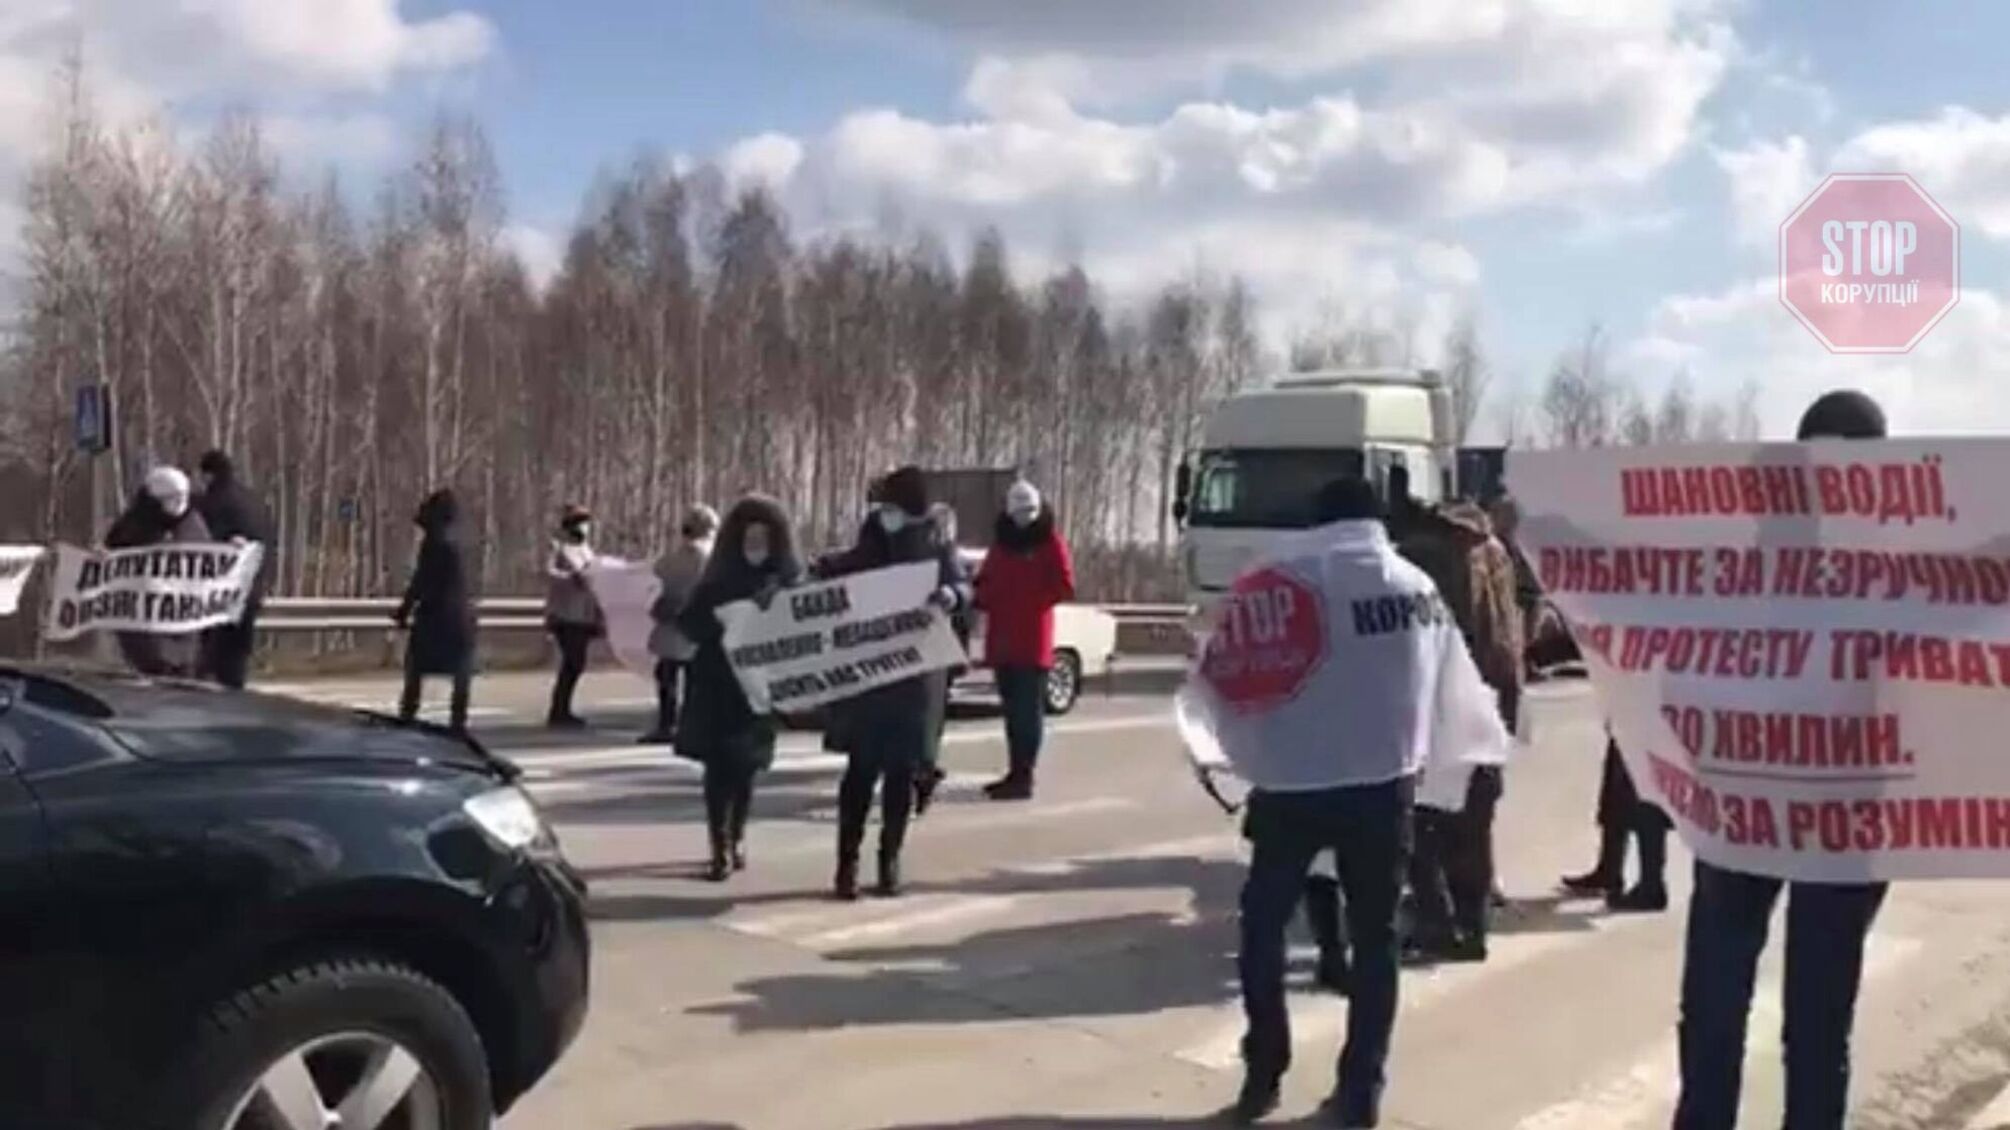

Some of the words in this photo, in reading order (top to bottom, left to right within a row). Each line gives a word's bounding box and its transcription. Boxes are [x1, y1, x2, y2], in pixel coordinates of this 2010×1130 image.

[1621, 465, 1811, 517] ШАНОВНІ
[1816, 454, 1957, 524] ВОДІЇ,
[1715, 548, 1764, 597] ЗА
[1773, 547, 2010, 605] НЕЗРУЧНО
[1620, 625, 1814, 680] ПРОТЕСТУ
[1712, 708, 1915, 767] ХВИЛИН.
[1723, 793, 1778, 850] ЗА
